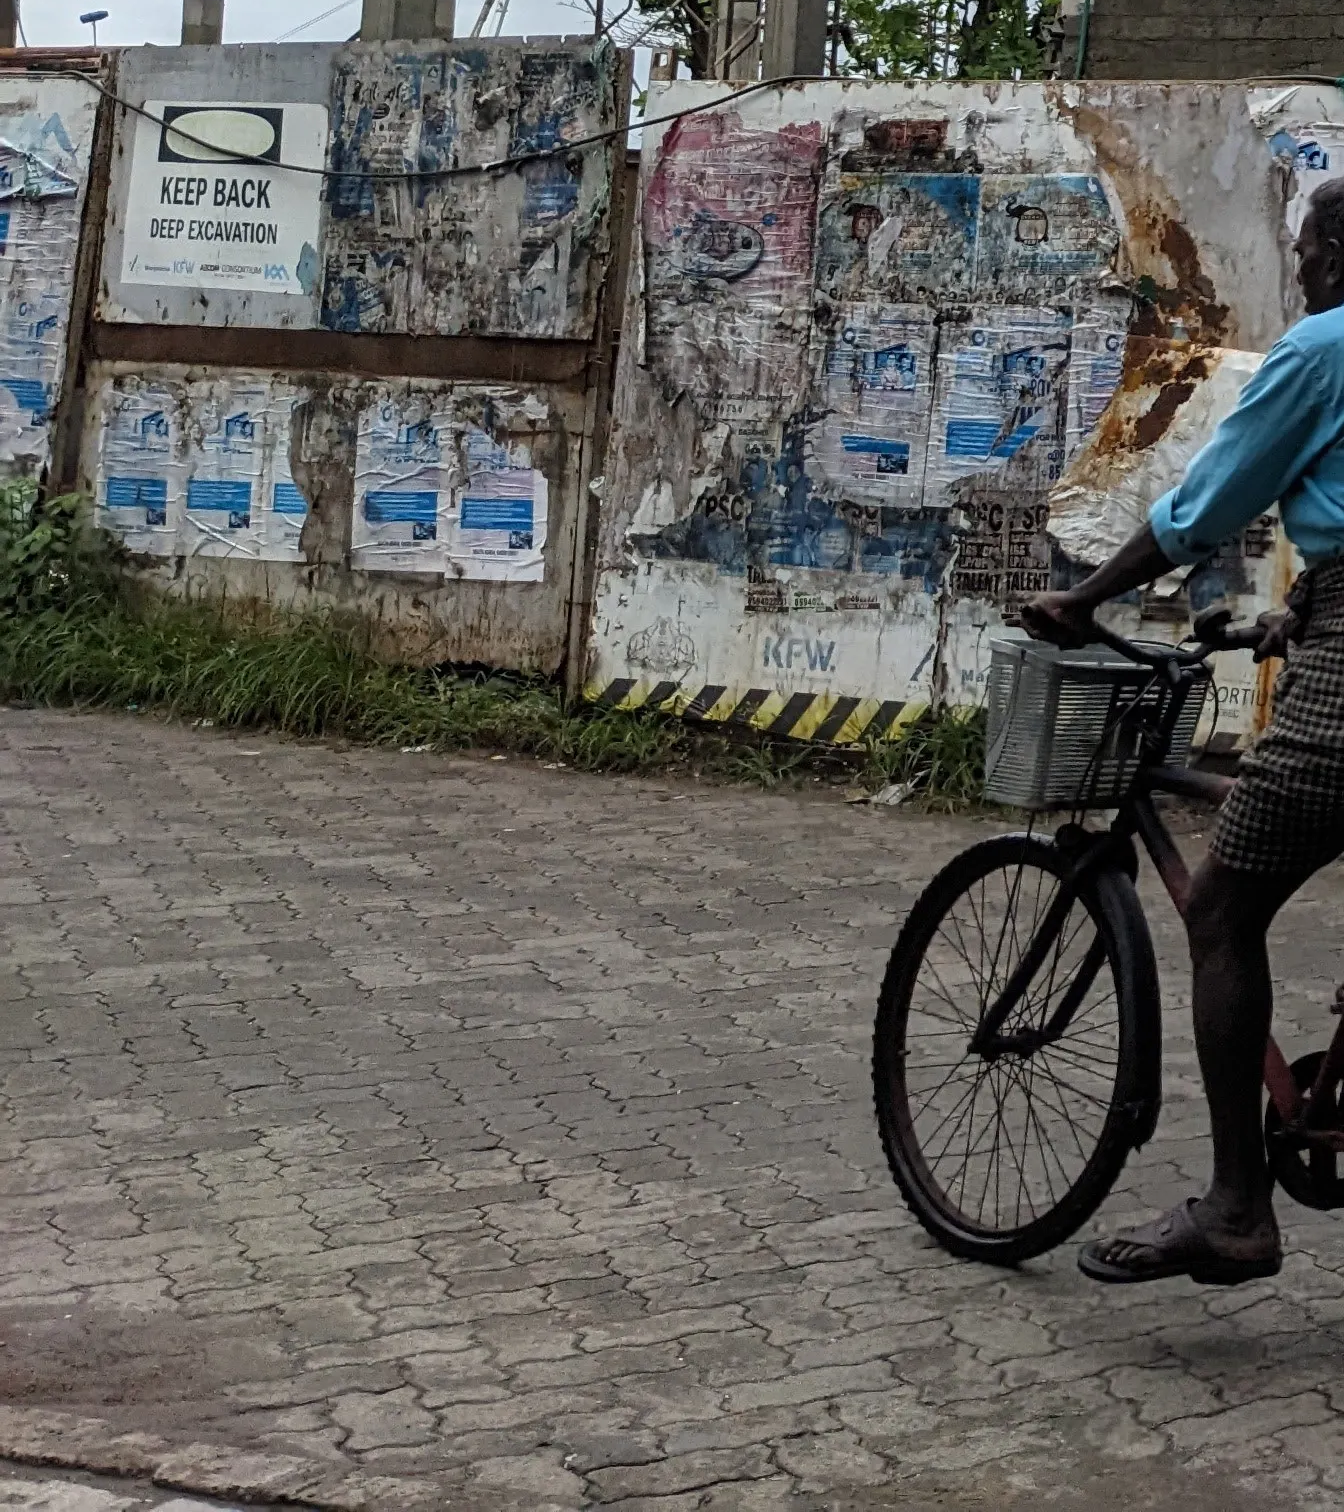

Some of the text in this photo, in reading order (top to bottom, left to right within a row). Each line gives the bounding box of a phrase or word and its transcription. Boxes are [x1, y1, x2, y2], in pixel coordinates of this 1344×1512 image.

[160, 176, 271, 208] KEEP BACK
[150, 218, 278, 244] DEEP EXCAVATION
[1005, 571, 1050, 591] TALENT
[1205, 686, 1268, 706] SORTIU
